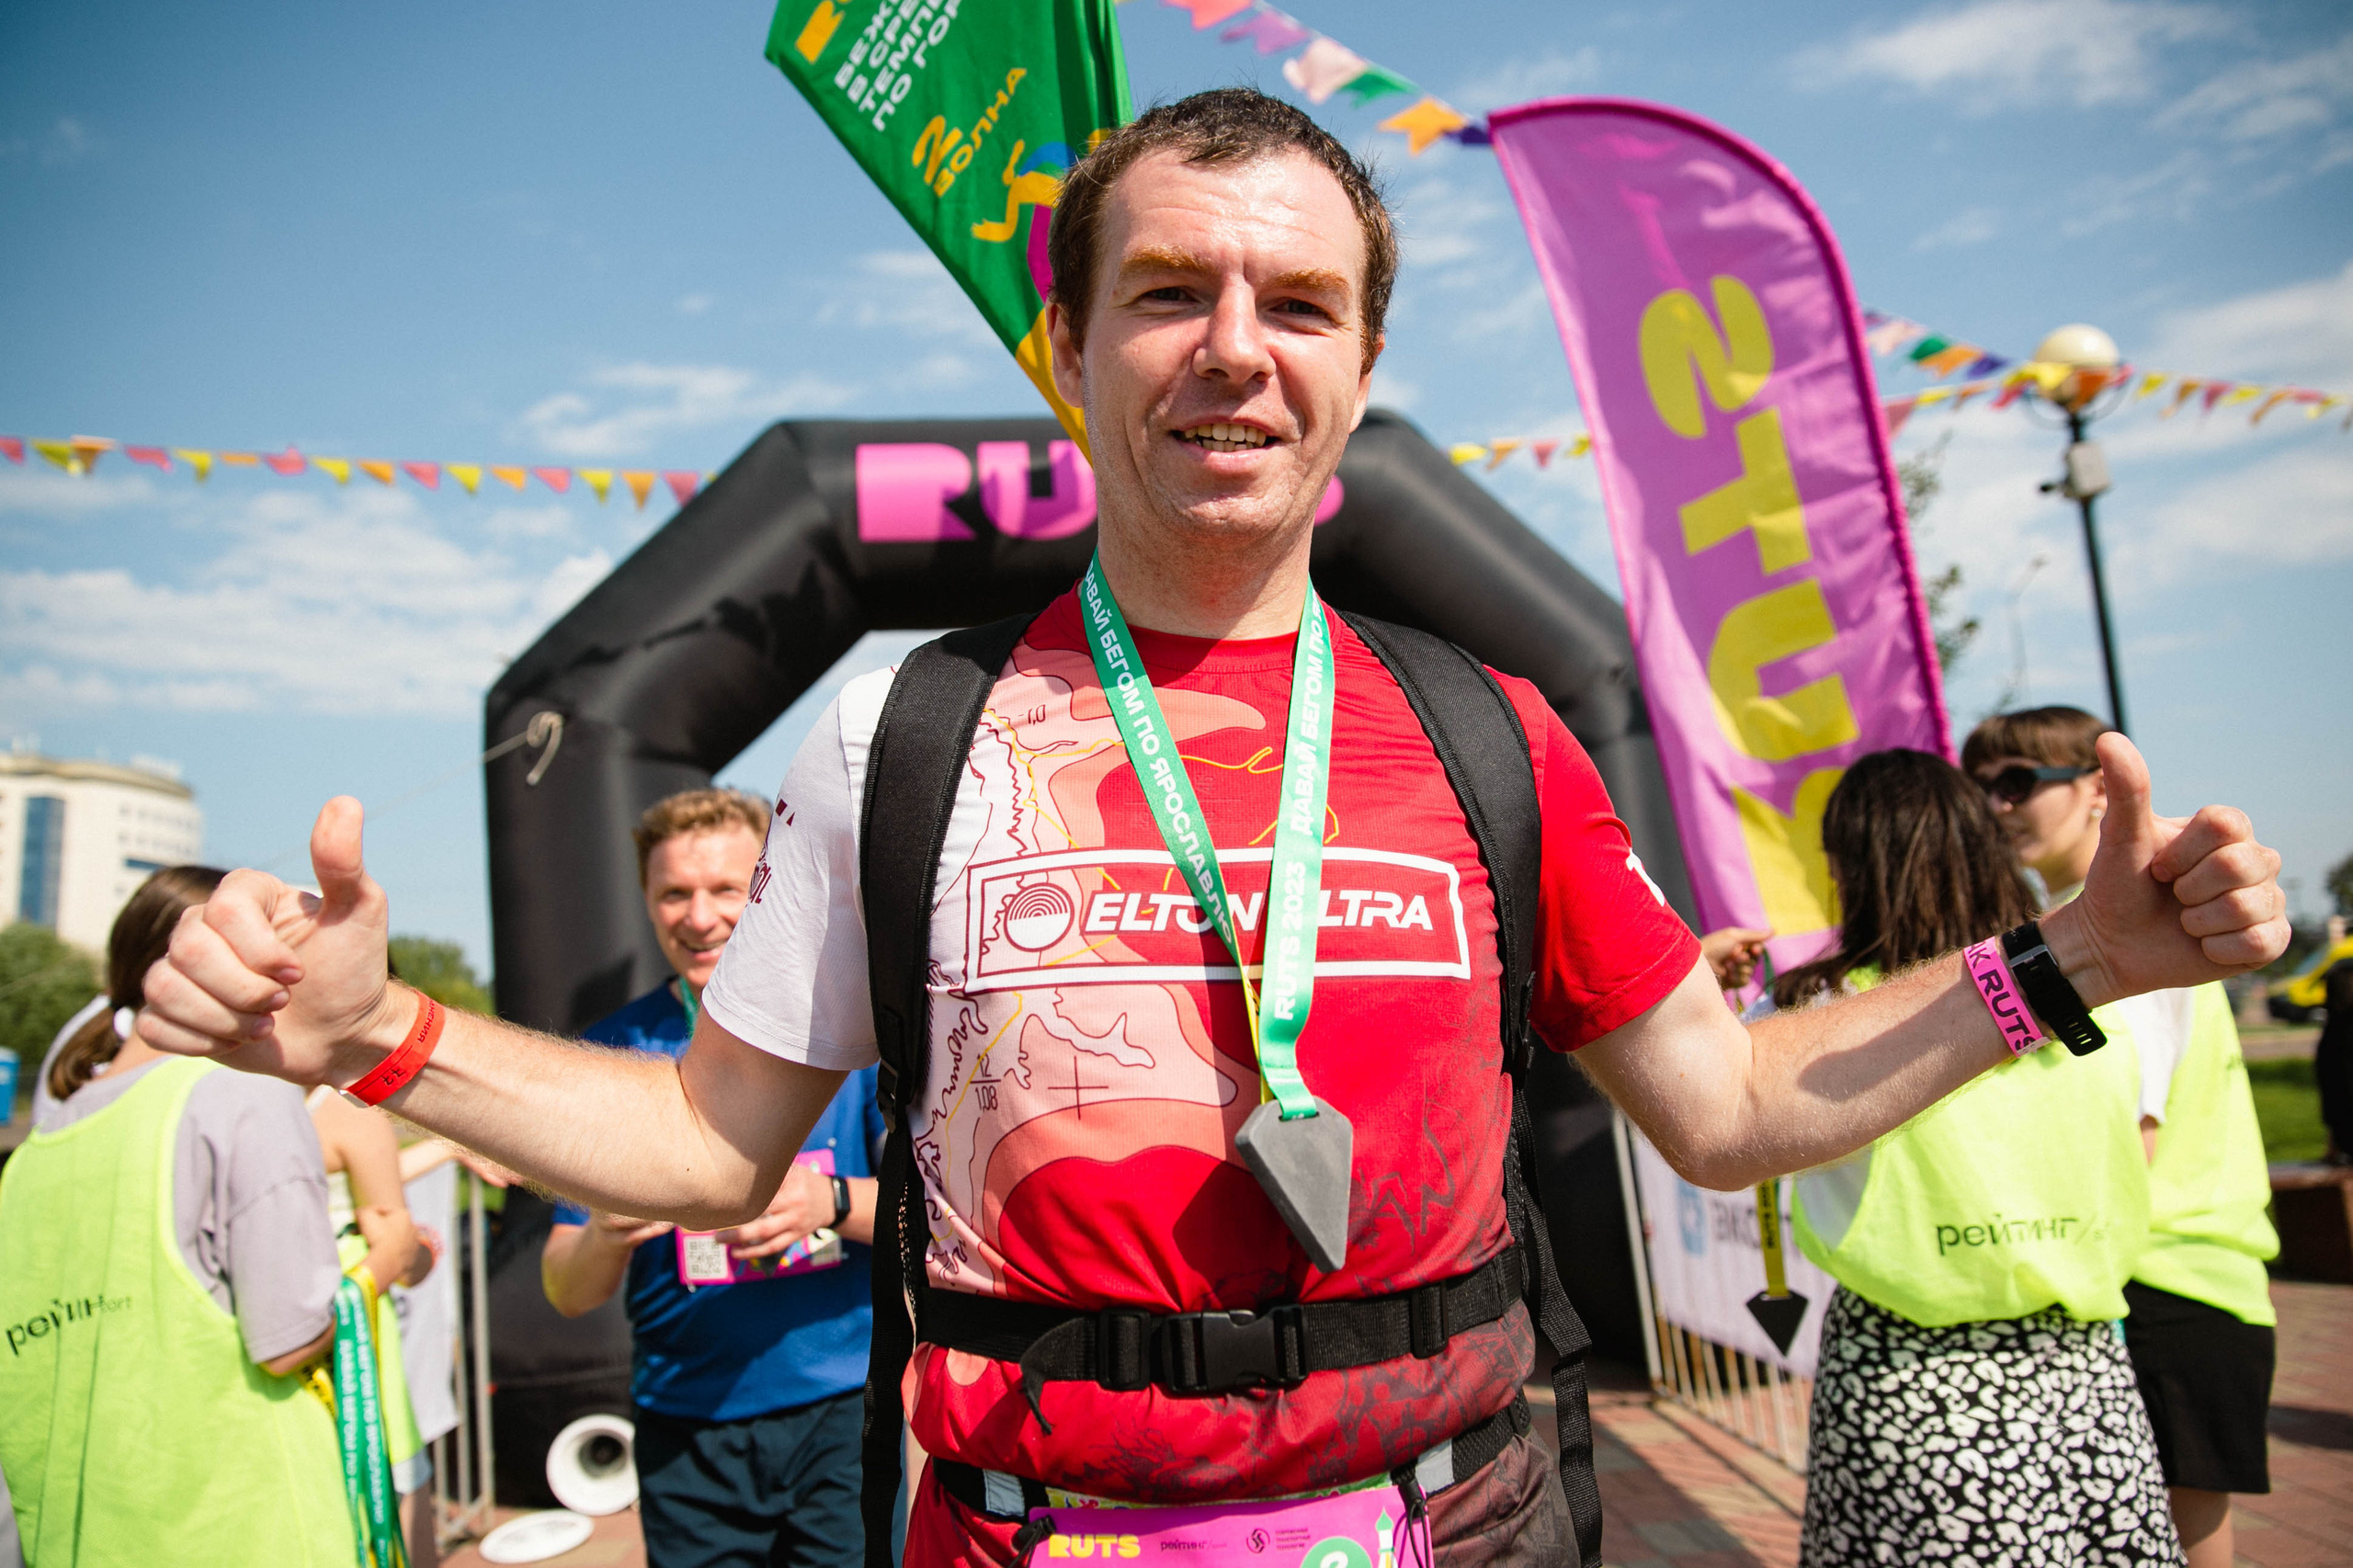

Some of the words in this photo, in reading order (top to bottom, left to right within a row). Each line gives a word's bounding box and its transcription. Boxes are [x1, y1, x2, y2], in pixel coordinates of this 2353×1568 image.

[834, 0, 900, 89] БЕЖ
[847, 74, 869, 104] В
[872, 74, 912, 131] ПО
[912, 115, 962, 185] 2
[934, 68, 1028, 198] ВОЛНА
[1309, 619, 1324, 654] ПО
[1300, 653, 1324, 744] БЕГОМ
[1100, 629, 1145, 715] БЕГОМ
[1133, 715, 1160, 756] ПО
[1149, 756, 1233, 944] ЯРОСЛАВЛЮ
[1290, 740, 1317, 836] ДАВАЙ
[1085, 890, 1264, 933] ELTON
[1316, 890, 1434, 931] LTRA
[1283, 860, 1306, 931] 2023
[1274, 935, 1301, 1020] RUTS
[1048, 1534, 1141, 1558] RUTS
